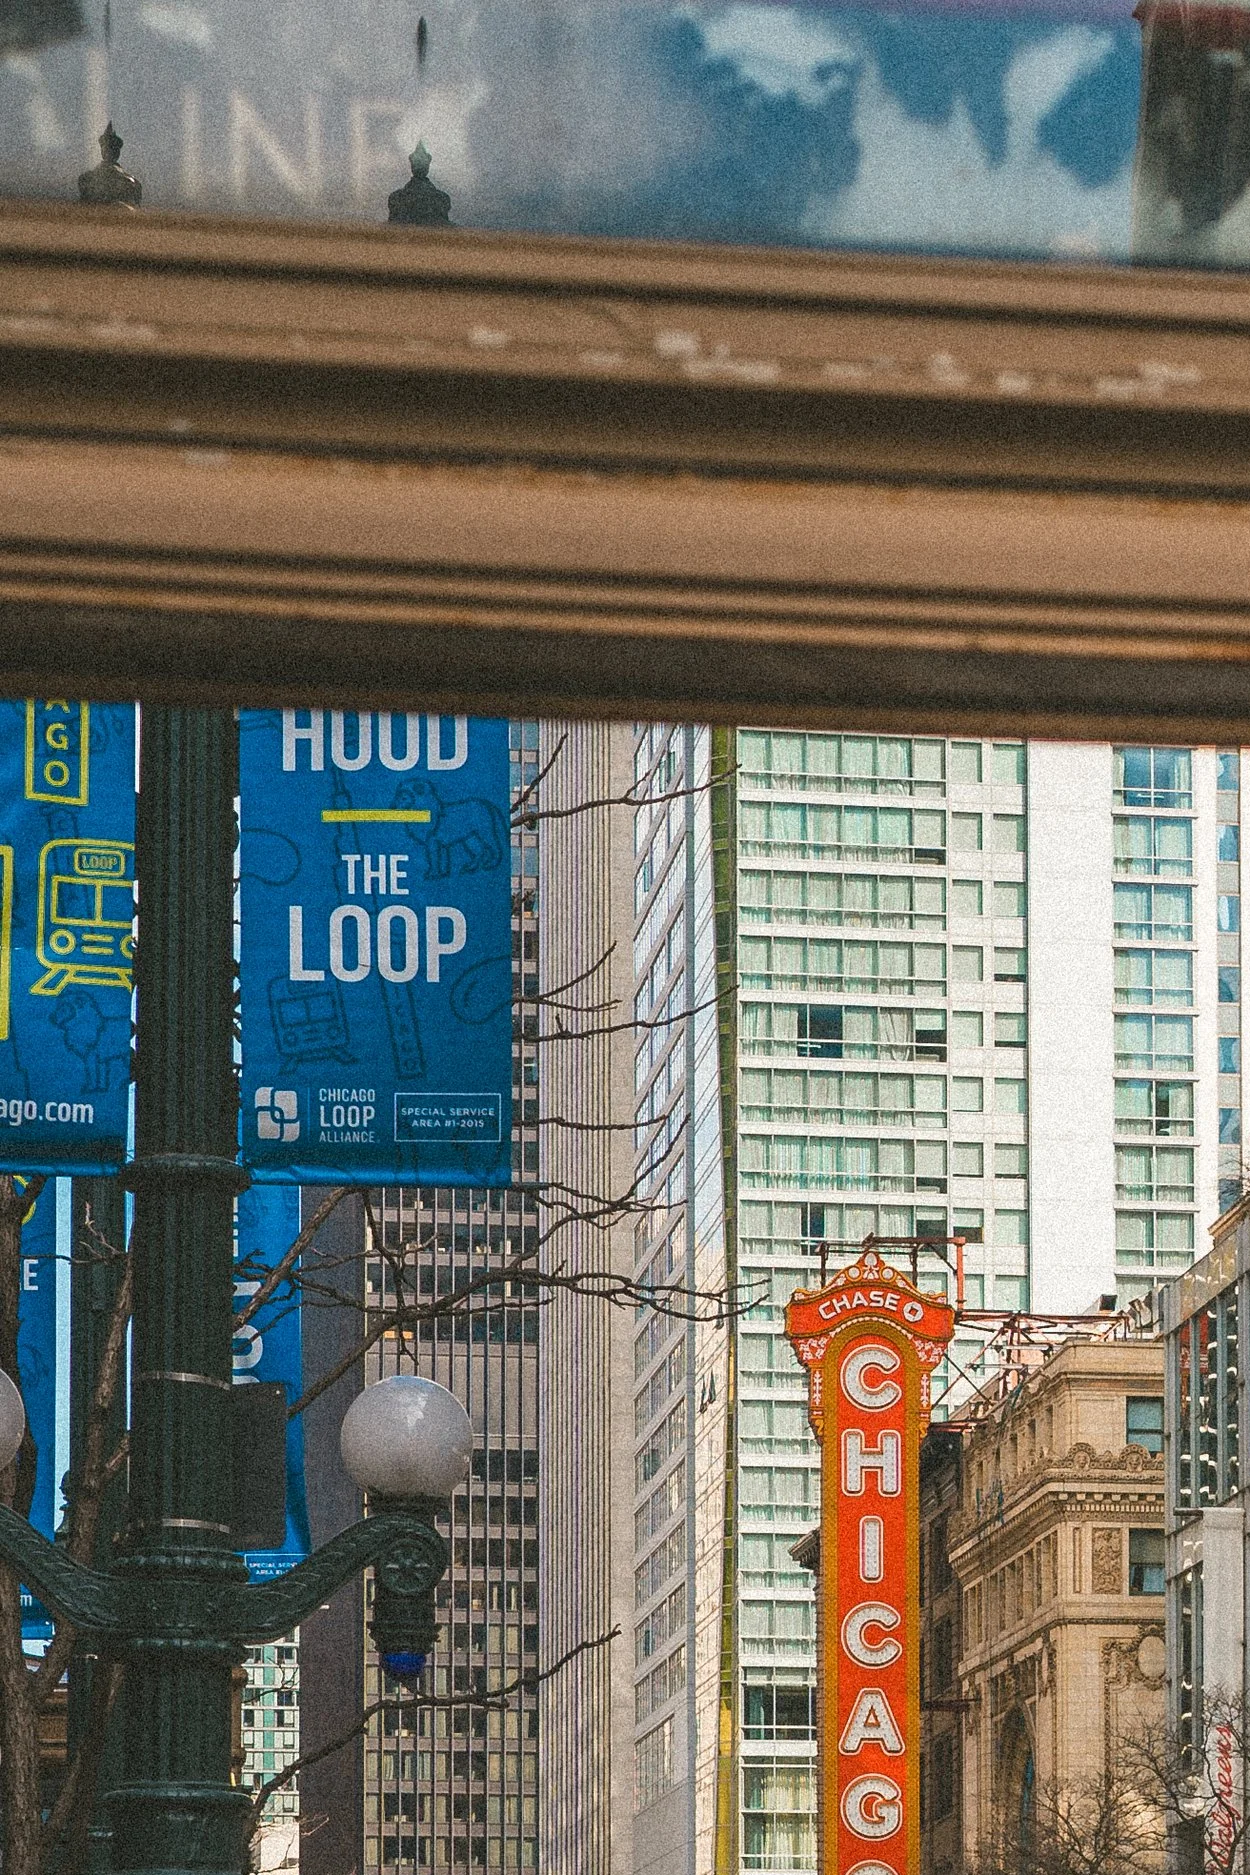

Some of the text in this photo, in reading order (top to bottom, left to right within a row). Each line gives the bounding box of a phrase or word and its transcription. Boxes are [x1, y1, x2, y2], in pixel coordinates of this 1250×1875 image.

[342, 854, 409, 895] THE
[289, 905, 467, 983] LOOP
[319, 1088, 376, 1103] CHICAGO
[320, 1105, 376, 1128] LOOP
[401, 1107, 496, 1117] SPECIAL SERVICE
[411, 1119, 441, 1128] AREA
[318, 1131, 375, 1143] ALLIANCE
[818, 1291, 900, 1320] CHASE
